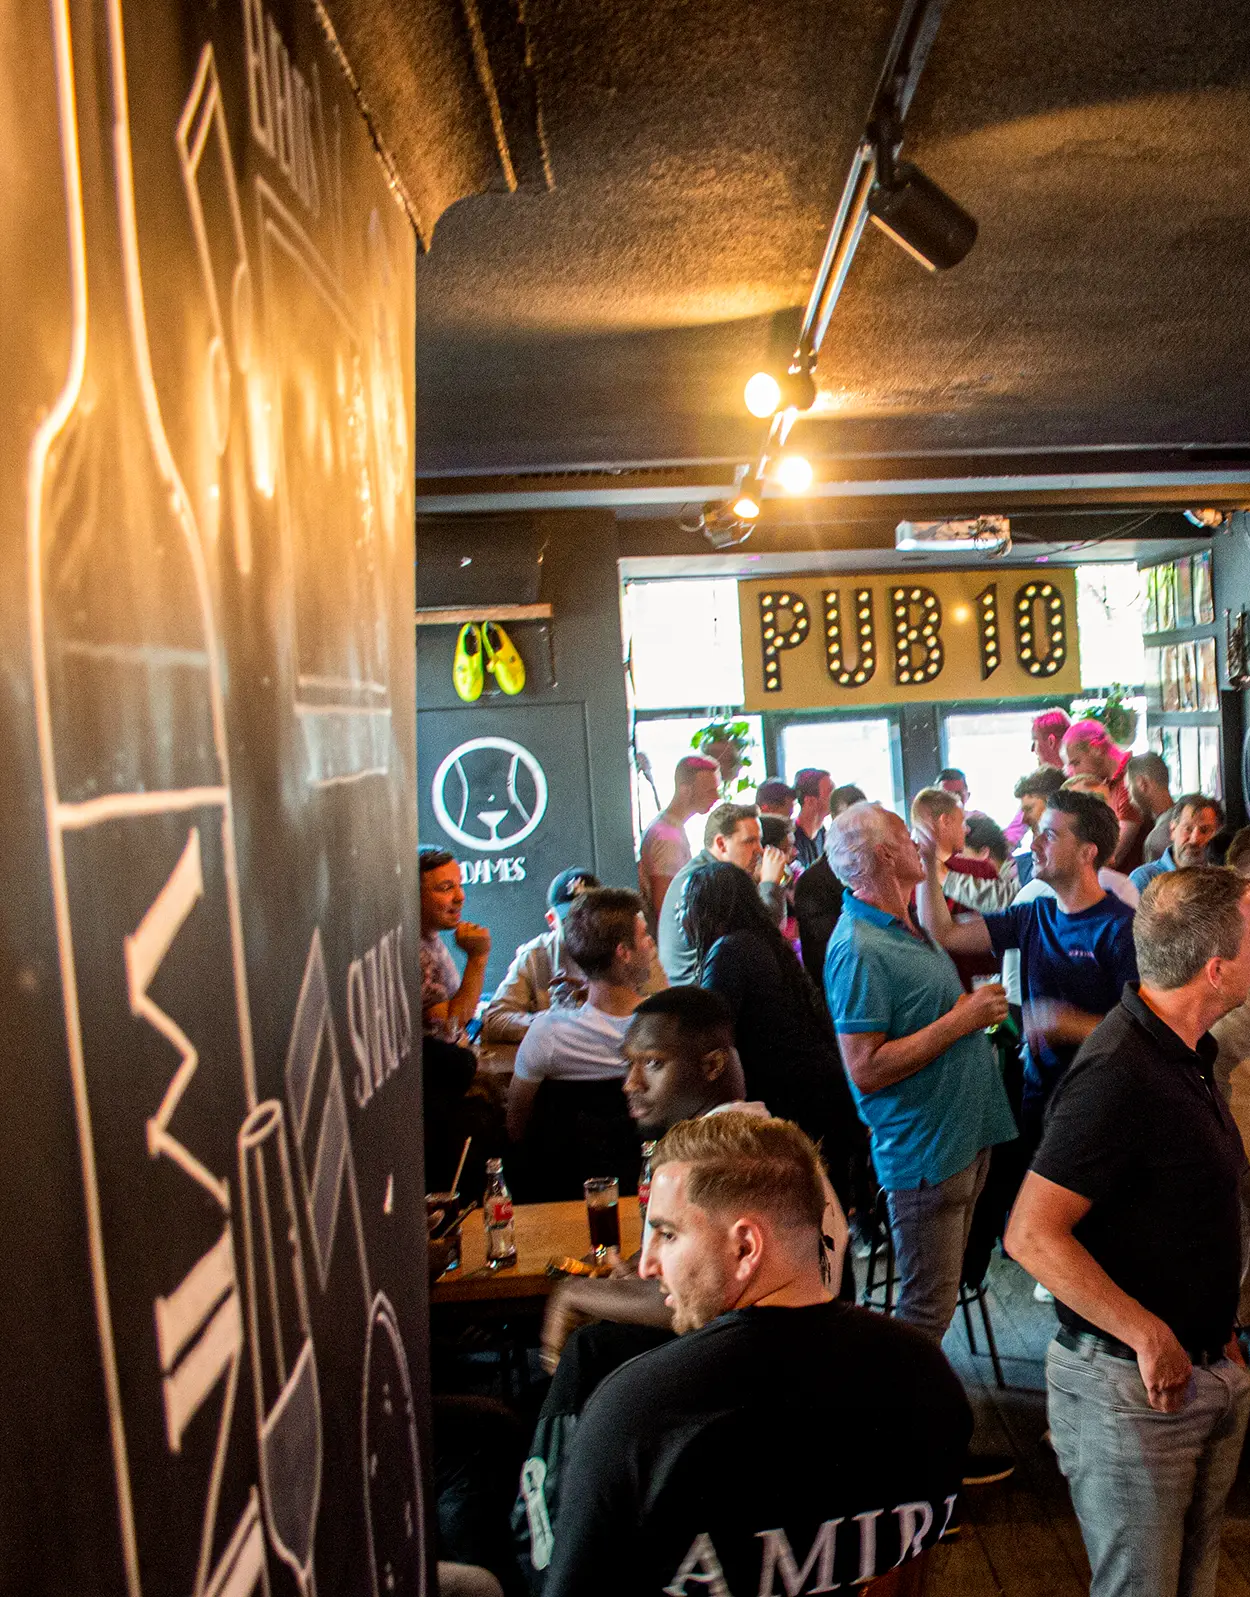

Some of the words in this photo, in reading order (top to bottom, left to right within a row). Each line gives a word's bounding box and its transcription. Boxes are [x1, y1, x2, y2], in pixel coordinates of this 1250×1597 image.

[758, 585, 945, 693] PUB
[972, 579, 1067, 681] 10
[459, 856, 526, 884] DAMES
